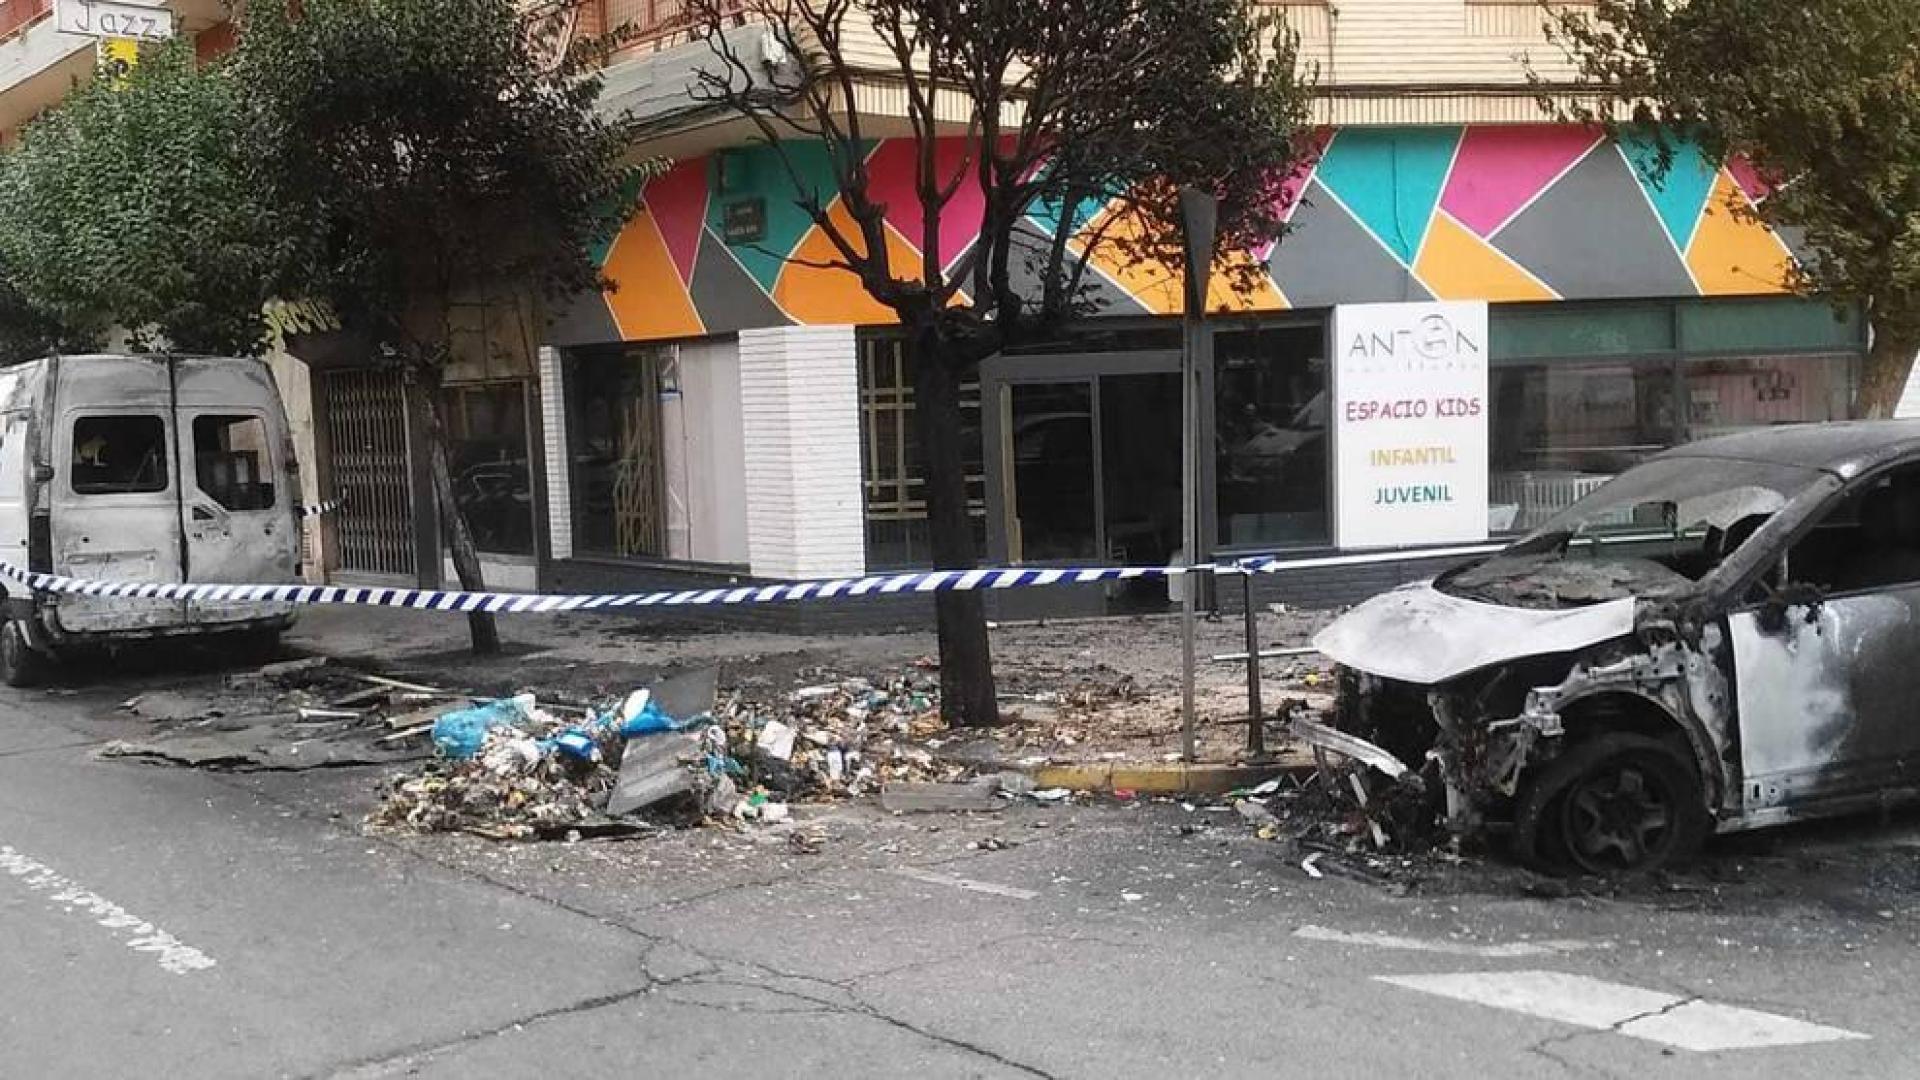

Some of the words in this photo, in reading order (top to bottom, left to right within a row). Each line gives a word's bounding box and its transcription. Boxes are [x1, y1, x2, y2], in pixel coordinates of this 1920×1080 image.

[1345, 400, 1428, 421] ESPACIO
[1436, 398, 1481, 418] KIDS
[1371, 447, 1456, 467] INFANTIL
[1374, 485, 1454, 504] JUVENIL
